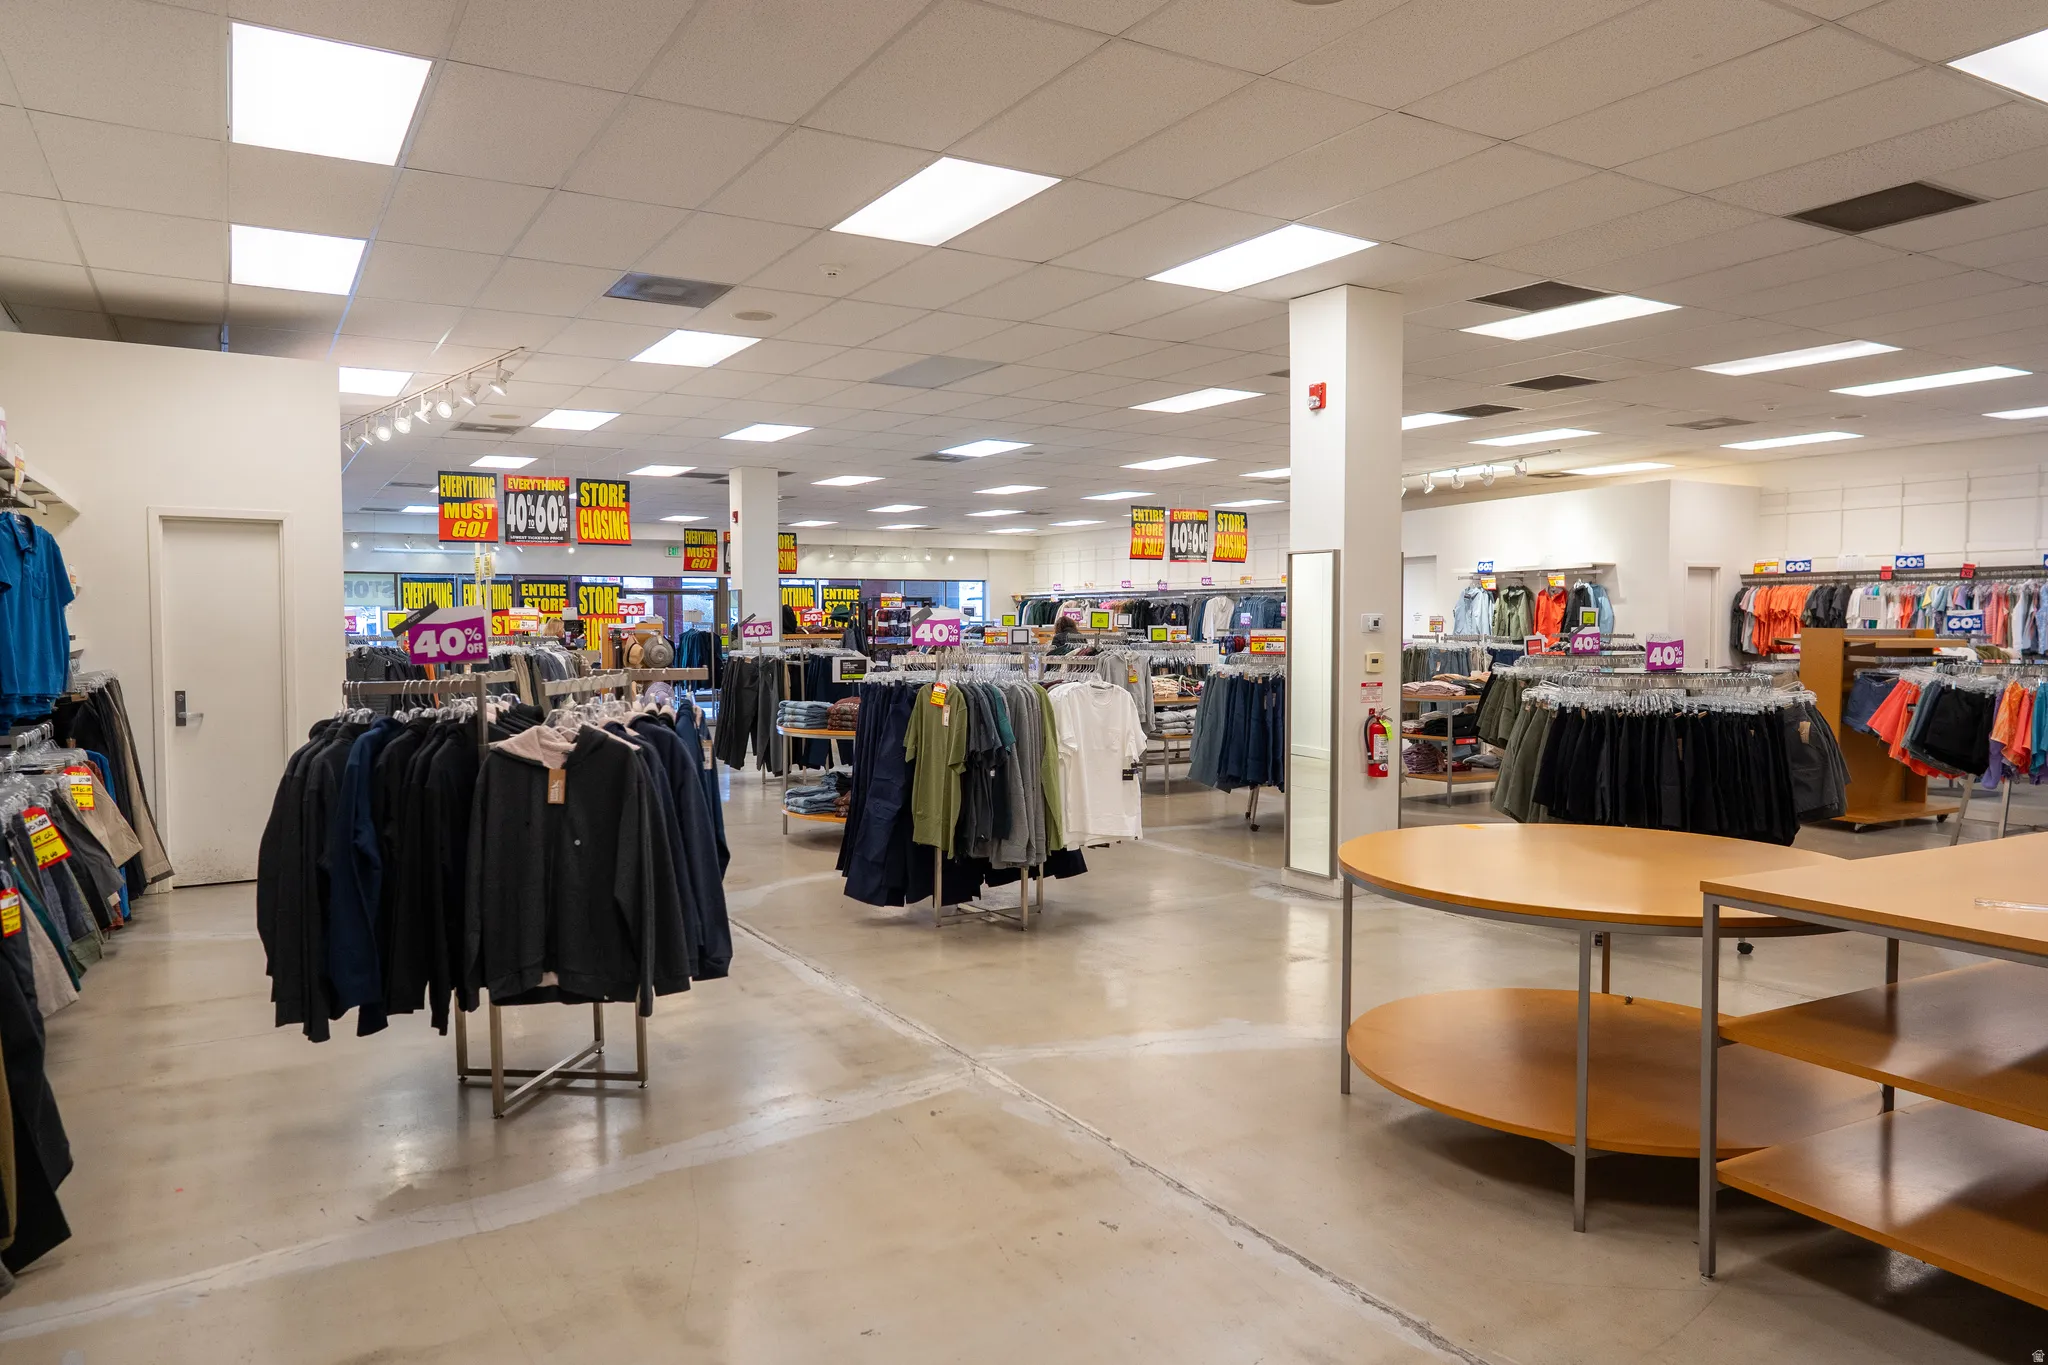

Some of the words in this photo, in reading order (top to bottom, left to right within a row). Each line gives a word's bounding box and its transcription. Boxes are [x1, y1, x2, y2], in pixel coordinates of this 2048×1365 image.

[440, 475, 496, 499] EVERYTHING
[508, 477, 566, 492] EVERYTHING
[580, 482, 626, 508] STORE
[444, 502, 495, 520] MUST
[1132, 508, 1164, 522] ENTIRE
[1173, 511, 1208, 521] EVERYTHING
[451, 520, 489, 538] GO!
[558, 517, 568, 532] OFF
[579, 509, 630, 541] CLOSING
[1134, 523, 1163, 536] STORE
[1217, 513, 1246, 533] STORE
[685, 529, 717, 545] EVERYTHING
[687, 547, 716, 558] MUST
[1131, 537, 1142, 555] ON
[1144, 538, 1164, 556] SALE!
[1215, 534, 1247, 559] CLOSING
[691, 558, 713, 569] GO!
[778, 551, 796, 570] SING
[402, 582, 453, 609] EVERYTHING
[521, 583, 567, 597] ENTIRE
[781, 587, 814, 607] OTHING
[823, 588, 859, 600] ENTIRE
[915, 623, 959, 643] 40%
[948, 635, 959, 643] OFF
[413, 627, 482, 658] 40%
[467, 643, 484, 654] OFF
[1574, 636, 1599, 650] 40%
[1649, 646, 1683, 666] 40%
